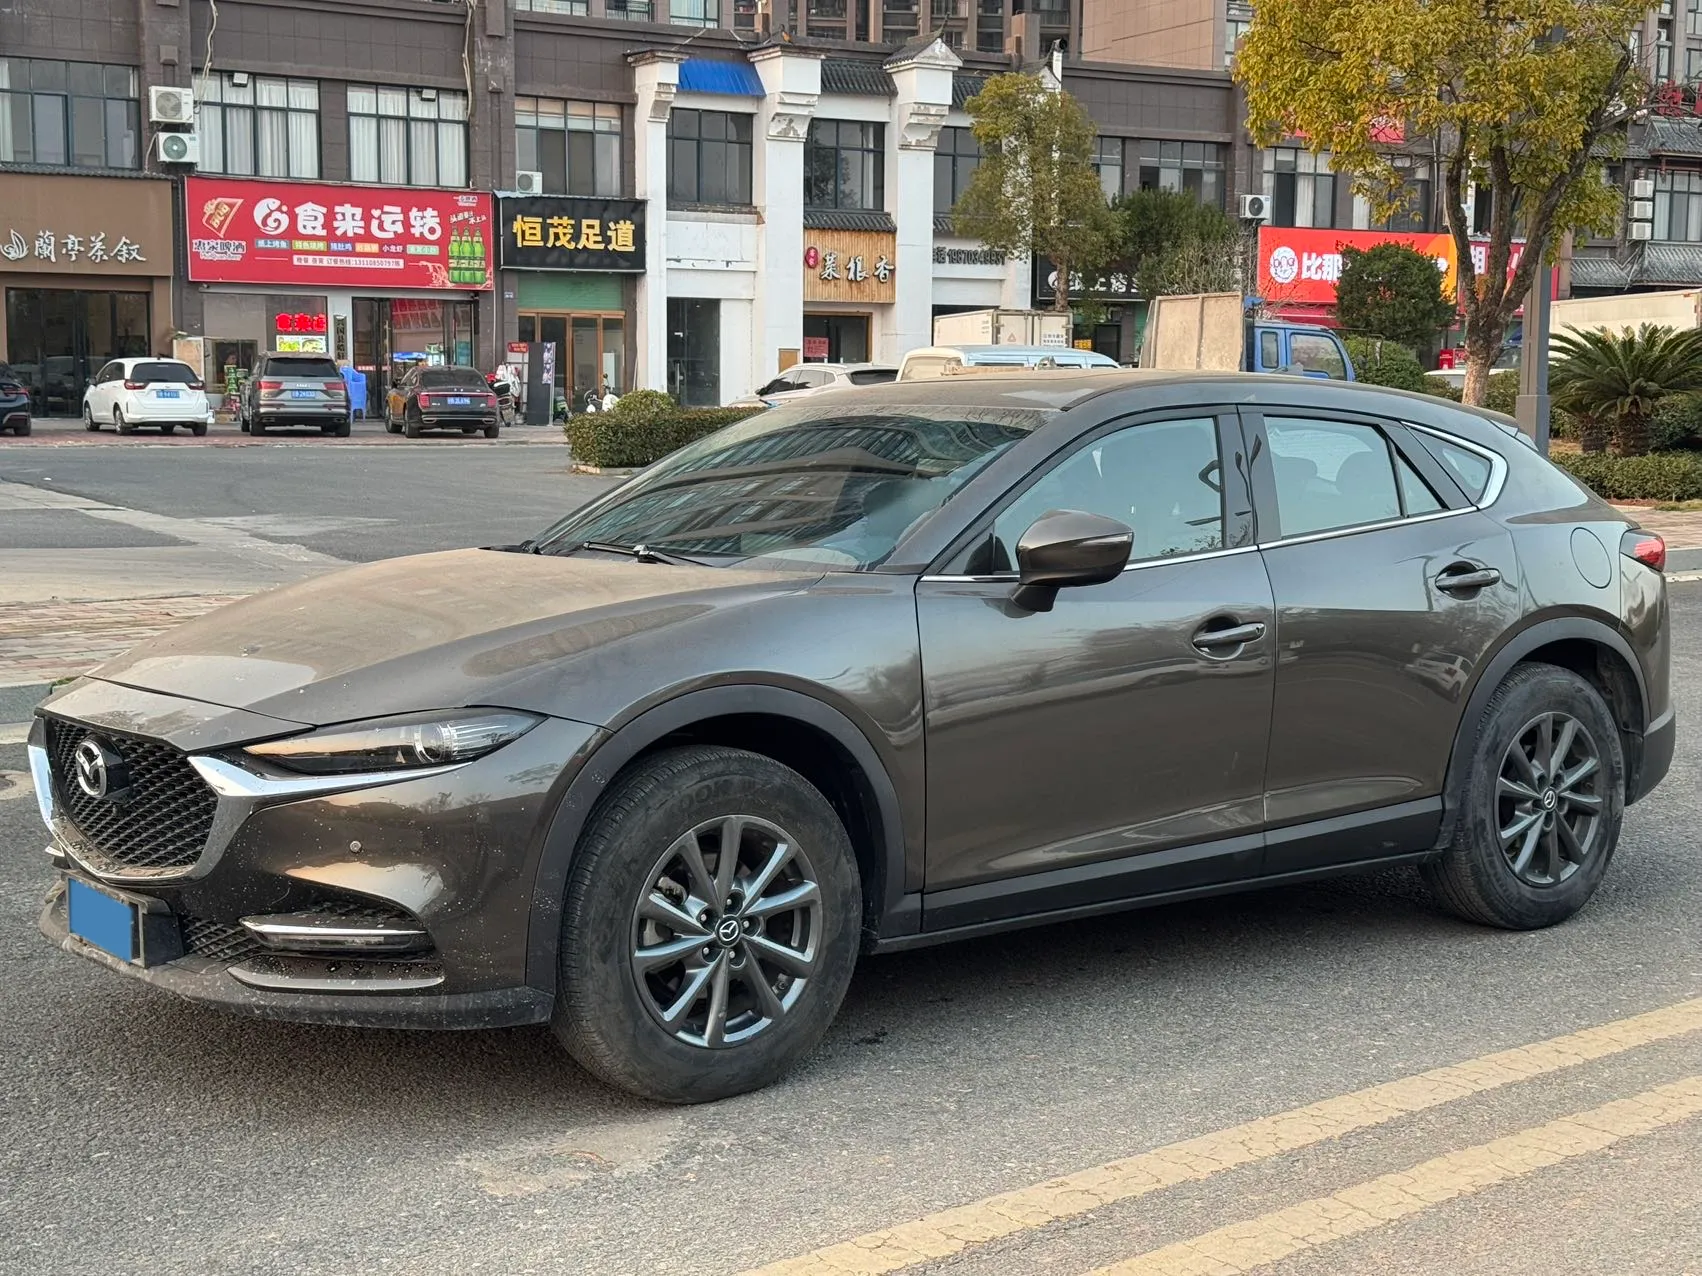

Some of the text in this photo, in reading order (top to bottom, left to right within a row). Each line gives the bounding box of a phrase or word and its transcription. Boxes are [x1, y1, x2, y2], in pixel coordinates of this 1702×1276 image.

[293, 201, 443, 240] 食来运转
[512, 214, 636, 252] 恒茂足道
